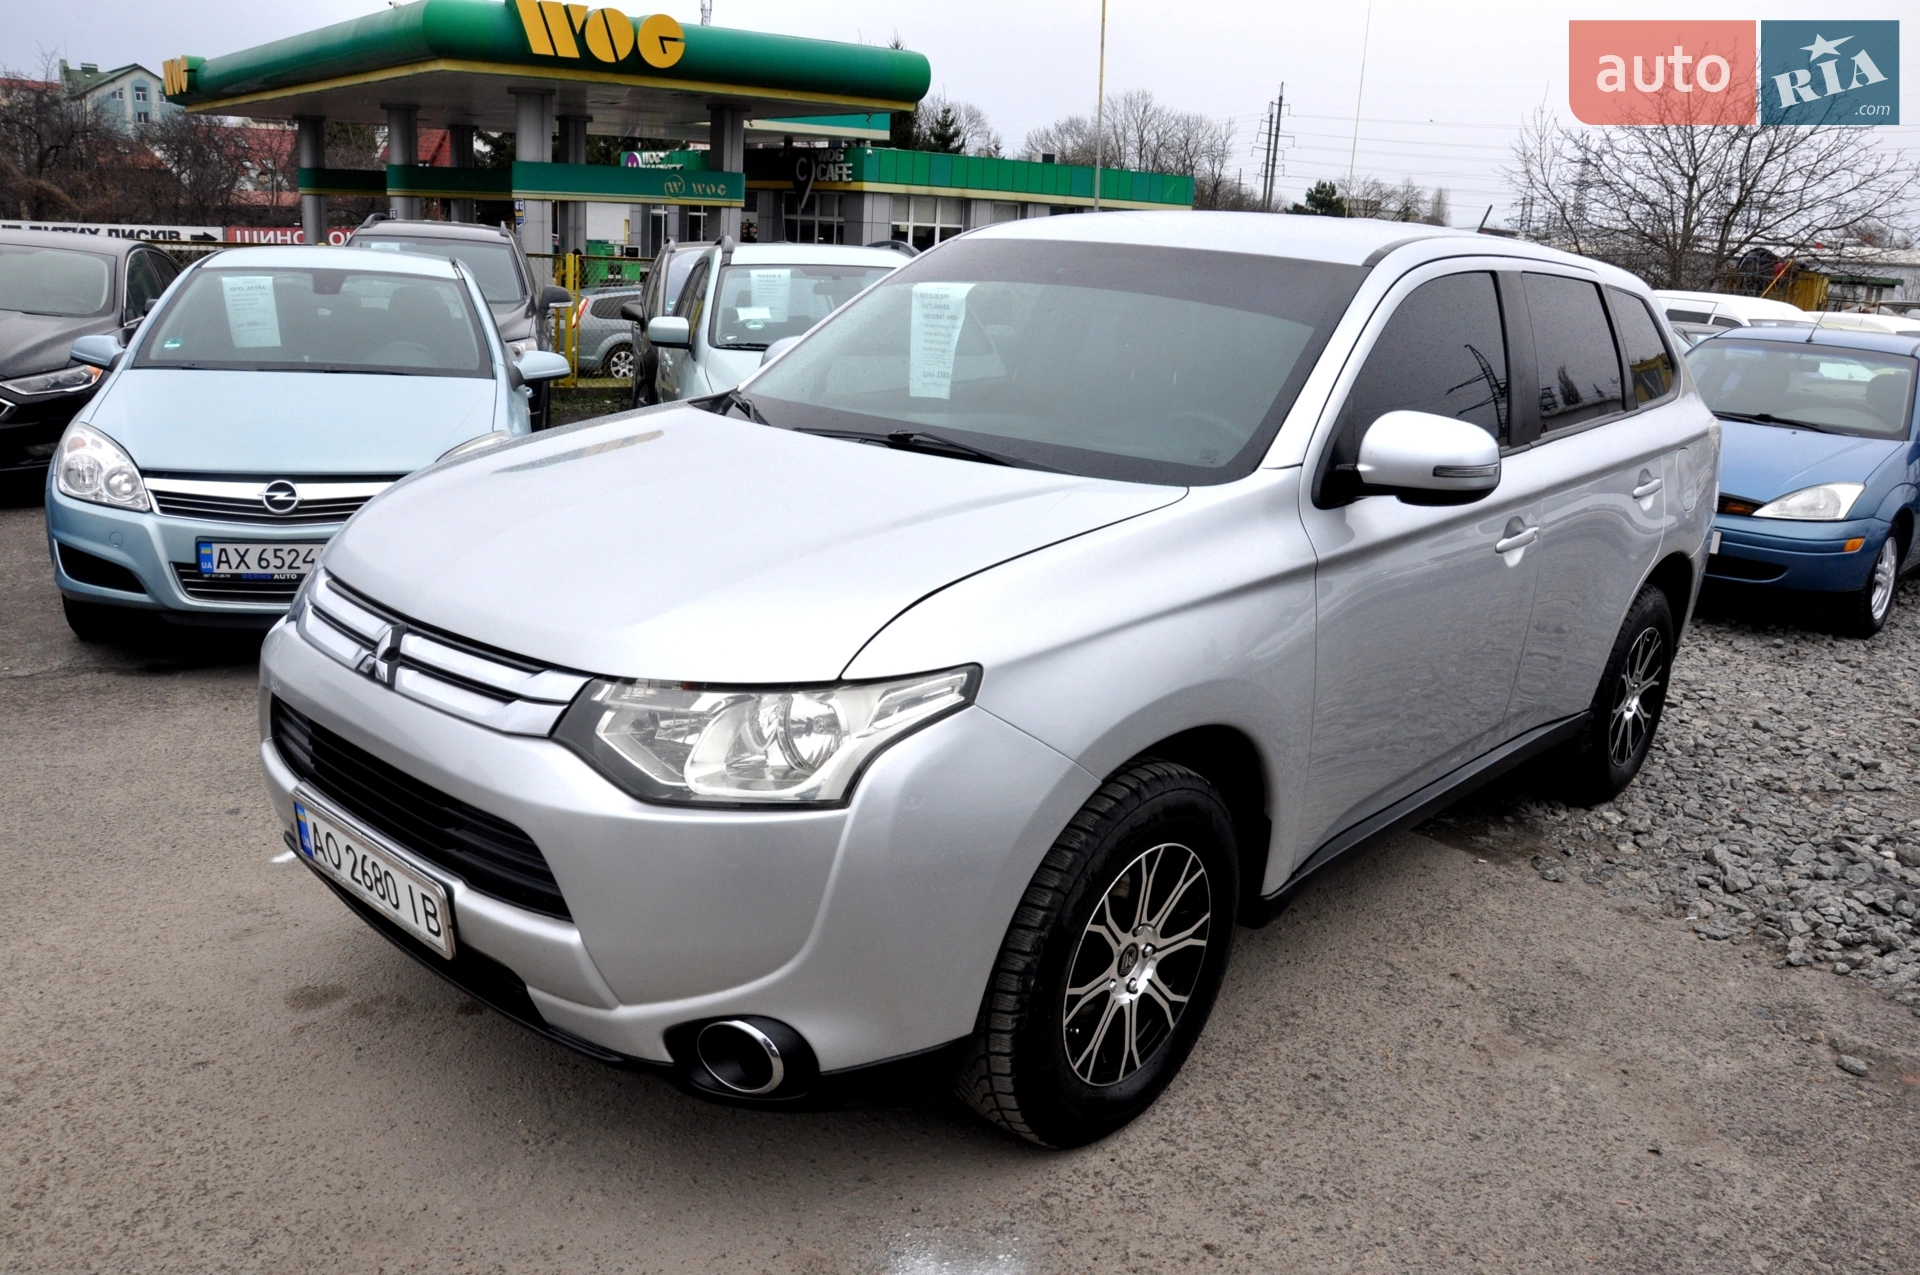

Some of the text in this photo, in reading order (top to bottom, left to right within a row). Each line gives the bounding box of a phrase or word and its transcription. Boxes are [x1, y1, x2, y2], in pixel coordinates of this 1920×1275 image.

[516, 0, 686, 69] WOG
[818, 149, 844, 162] WOG
[816, 163, 853, 182] CAFE
[691, 182, 727, 196] WOG
[201, 561, 213, 570] UA
[216, 547, 251, 570] AX
[312, 821, 342, 871] AO
[345, 844, 400, 910] 2680
[408, 884, 442, 938] IB
